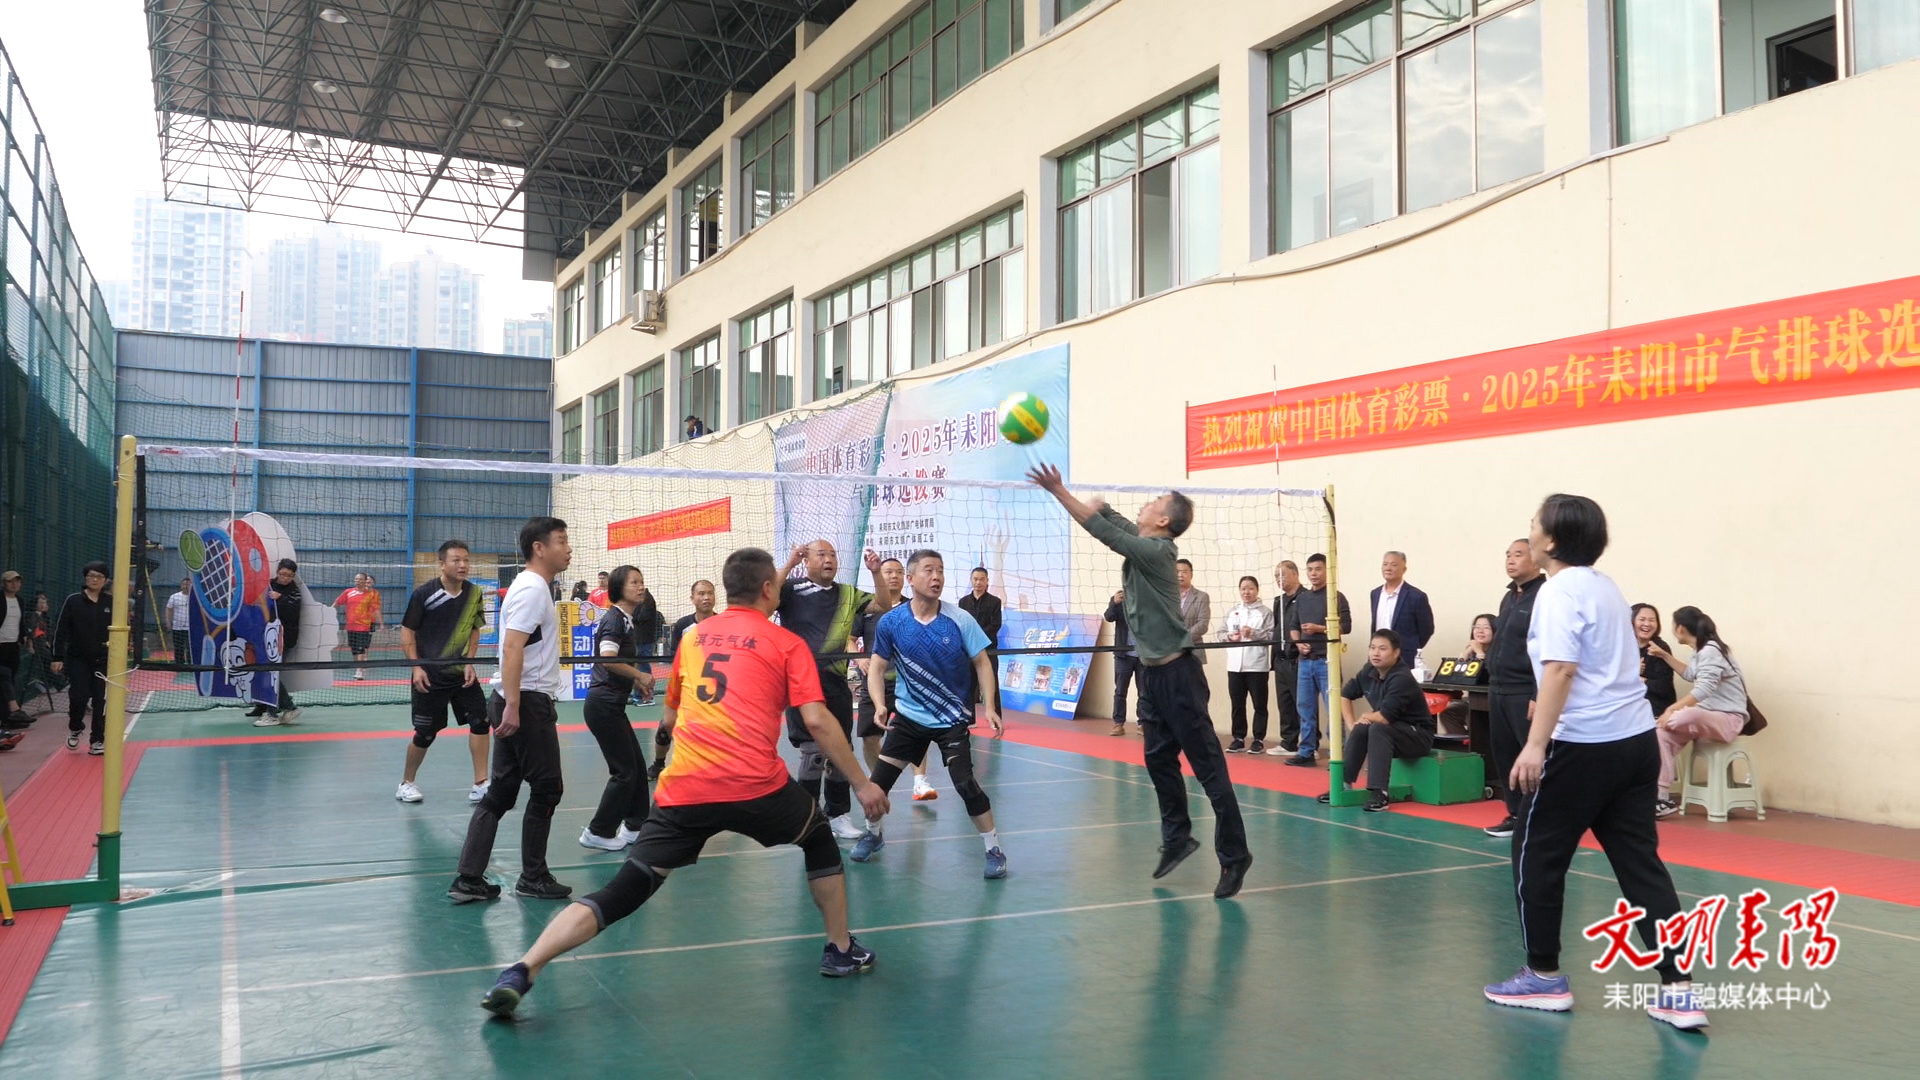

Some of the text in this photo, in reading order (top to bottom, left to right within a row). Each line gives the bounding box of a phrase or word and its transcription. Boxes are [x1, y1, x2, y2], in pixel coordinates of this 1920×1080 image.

[806, 409, 999, 475] 中国体育彩票·2025年耒阳
[696, 652, 731, 704] 5
[1440, 661, 1455, 675] 8
[1465, 661, 1479, 676] 9
